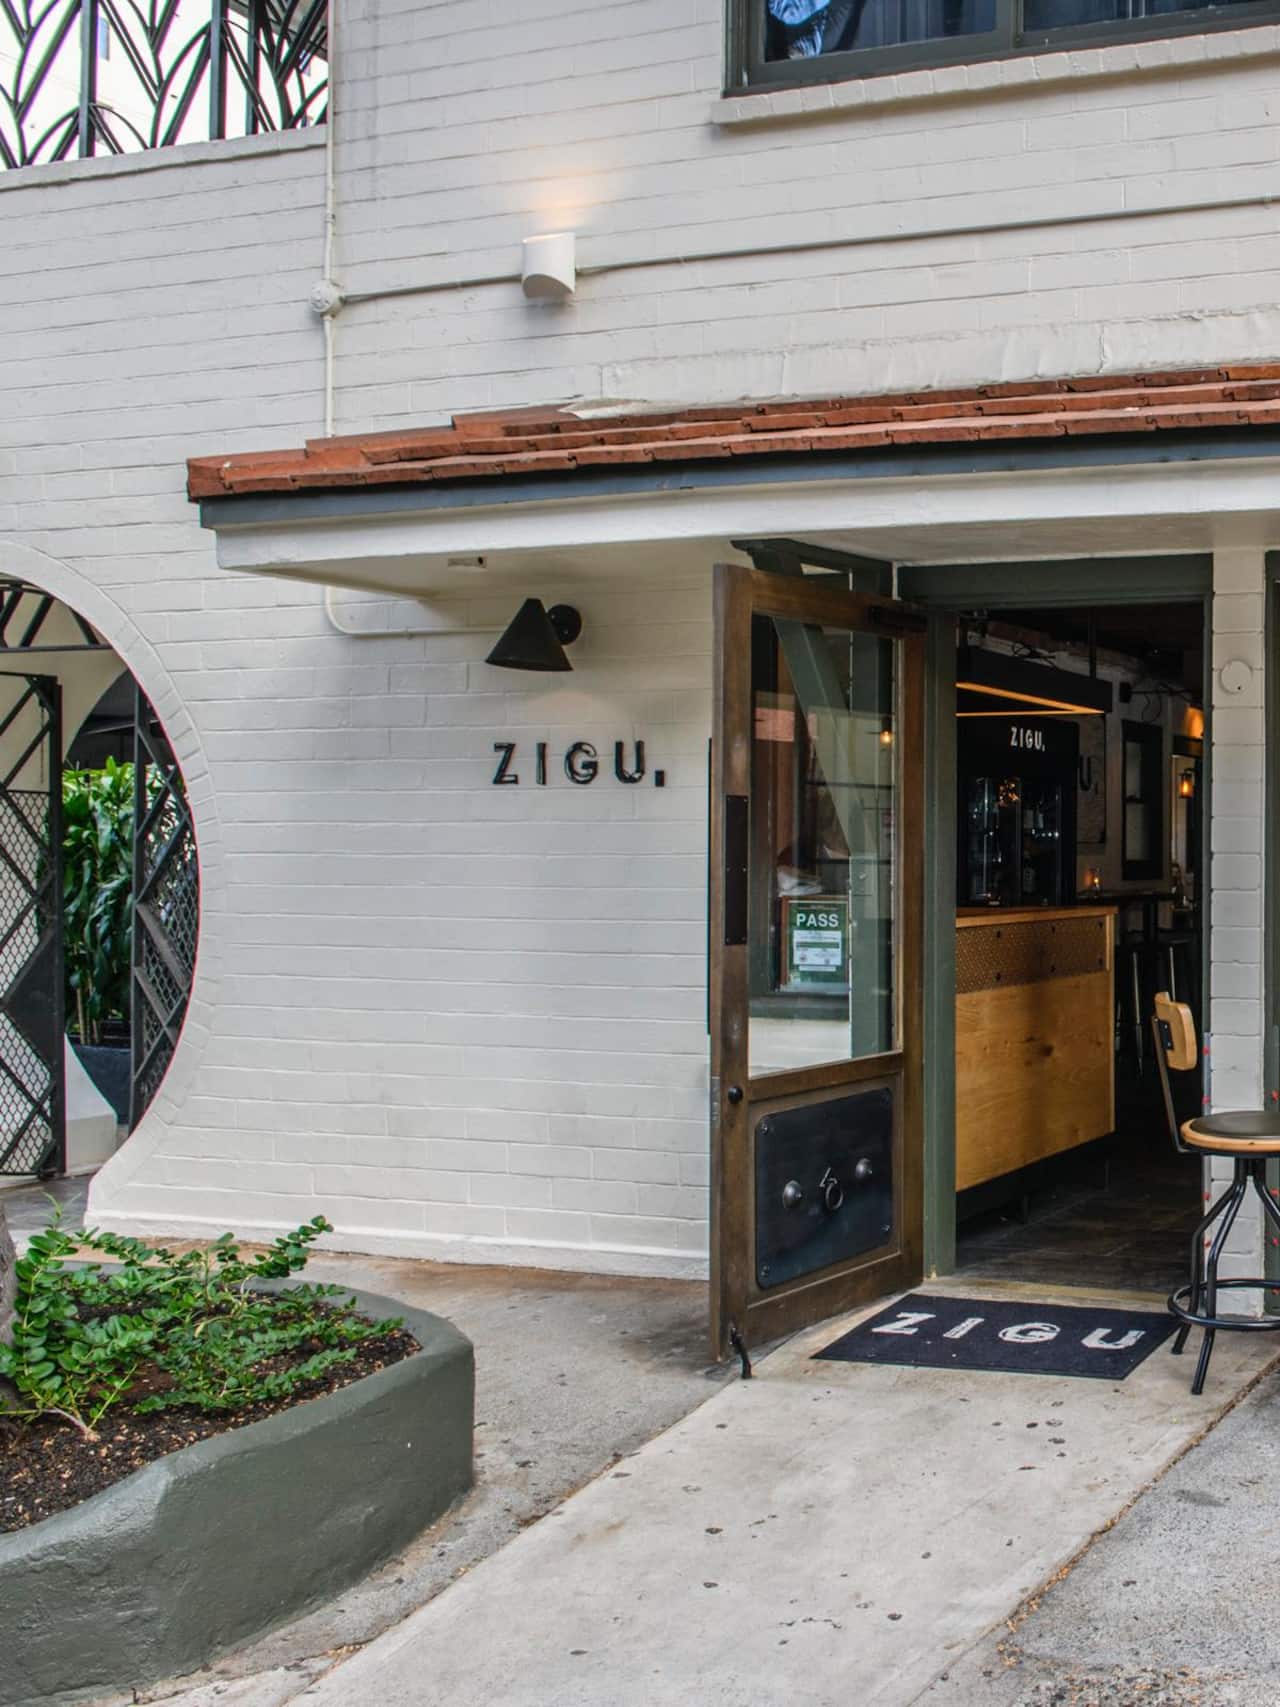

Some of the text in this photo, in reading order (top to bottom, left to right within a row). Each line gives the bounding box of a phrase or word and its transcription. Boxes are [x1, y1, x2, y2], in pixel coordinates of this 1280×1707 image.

[1010, 726, 1046, 752] ZIGU.
[493, 740, 666, 787] ZIGU.
[796, 913, 839, 927] PASS
[871, 1312, 1147, 1350] ZIGU
